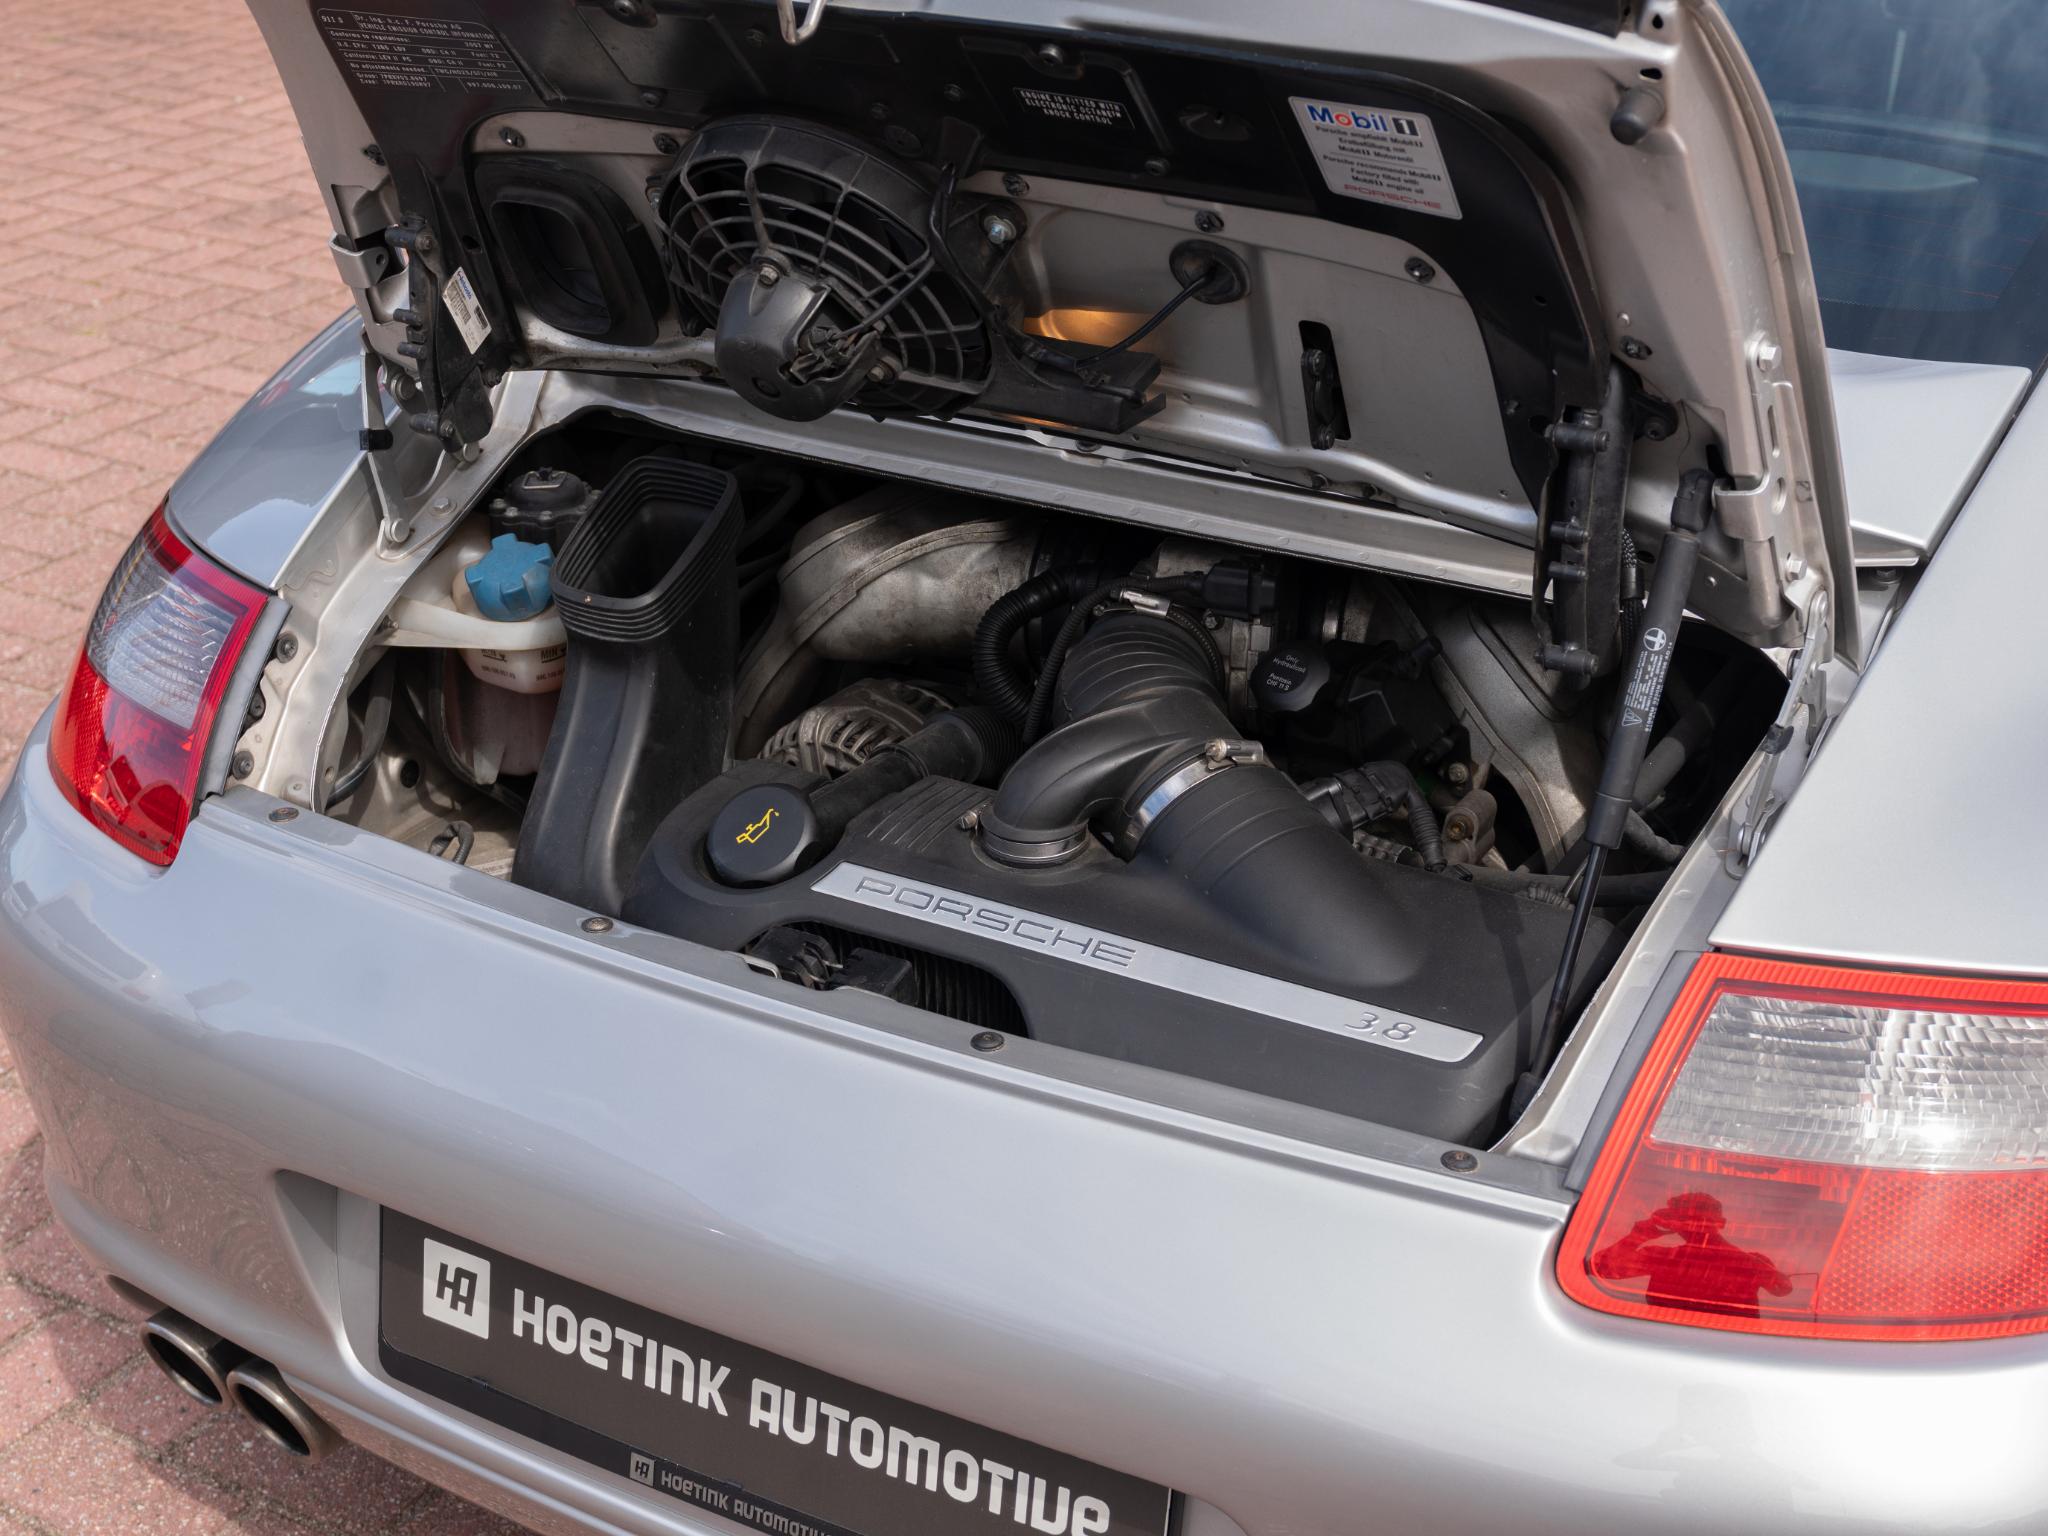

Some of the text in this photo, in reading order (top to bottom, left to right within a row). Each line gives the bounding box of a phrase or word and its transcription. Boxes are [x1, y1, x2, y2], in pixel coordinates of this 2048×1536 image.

[1307, 104, 1388, 132] Mobil
[1344, 184, 1441, 209] PORSCHE
[855, 876, 1136, 968] PORSCHE
[1344, 1010, 1417, 1042] 3.8
